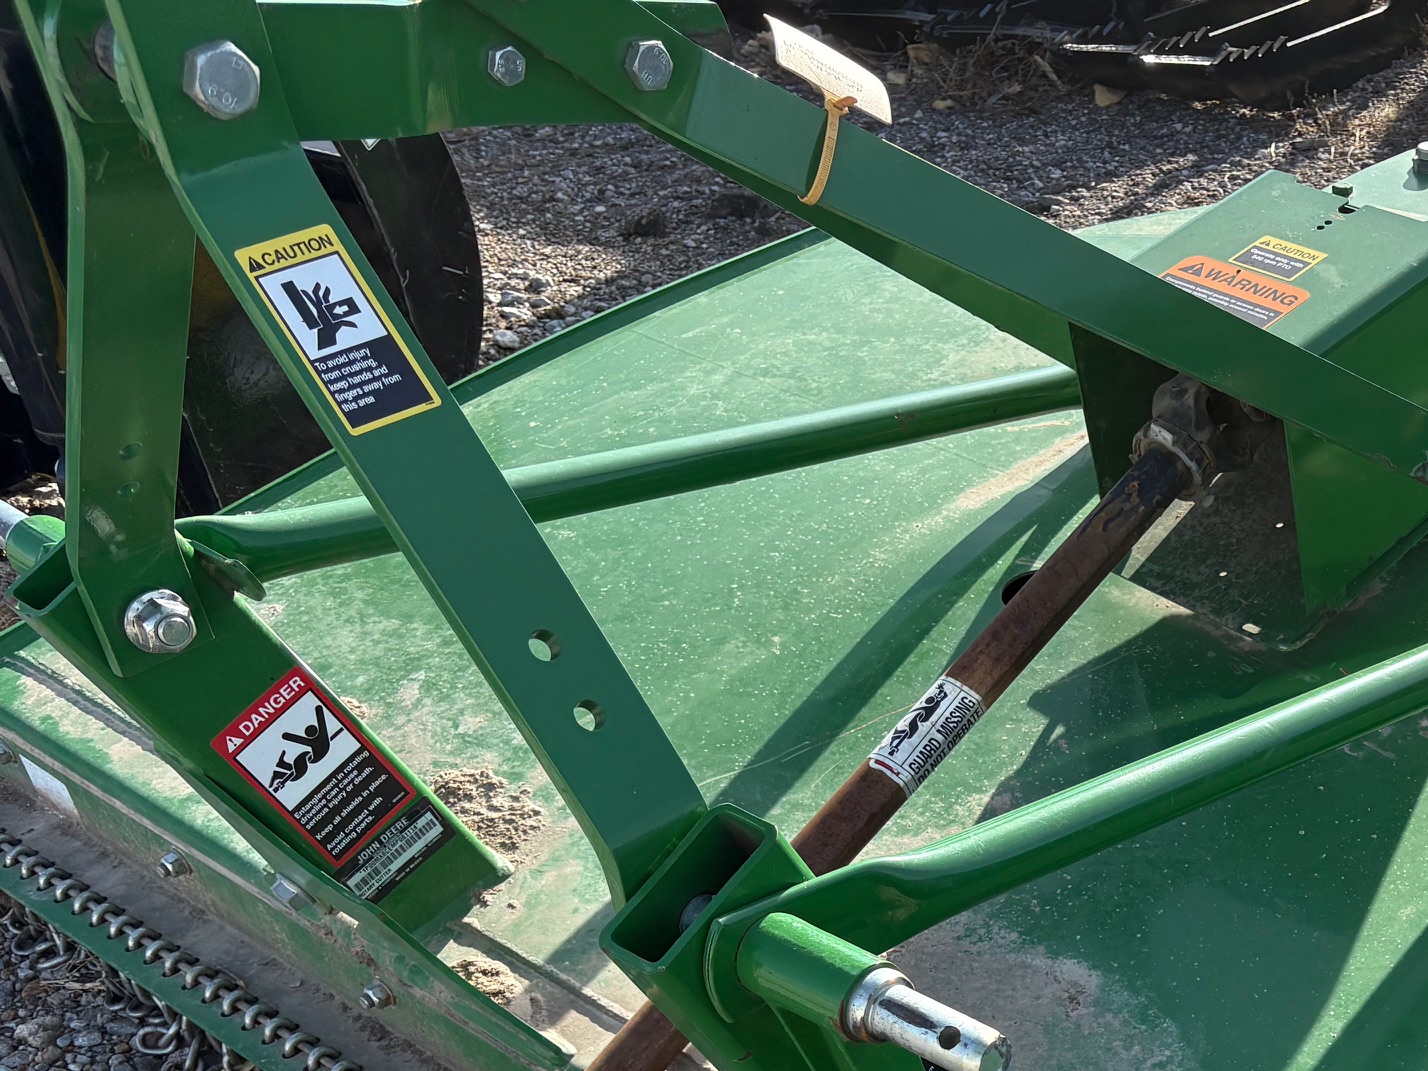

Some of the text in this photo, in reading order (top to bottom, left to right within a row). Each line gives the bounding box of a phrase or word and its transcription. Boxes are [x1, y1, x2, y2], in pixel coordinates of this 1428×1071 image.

[261, 234, 334, 266] CAUTION
[1273, 243, 1319, 261] CAUTION
[1276, 262, 1292, 270] PTO
[1204, 268, 1299, 307] WARNING
[314, 347, 371, 371] To avoid injury
[322, 358, 379, 382] from crushing,
[328, 365, 389, 392] keep hands and
[335, 374, 402, 402] fingers away from
[341, 396, 376, 412] this area
[238, 676, 305, 737] DANGER
[908, 696, 976, 775] GUARD MISSING
[930, 745, 951, 773] NOT
[294, 750, 370, 819] Entanglement in rotating
[300, 770, 358, 825] driveline can cause
[306, 766, 375, 830] serious injury or death.
[315, 774, 389, 840] Keep all shields in place.
[326, 831, 346, 851] Avoid
[344, 808, 370, 834] contact
[367, 796, 383, 812] with
[331, 830, 357, 856] rotating
[356, 815, 375, 834] parts.
[358, 841, 381, 865] JOHN
[380, 816, 409, 843] DEERE
[375, 868, 393, 883] CUTTER
